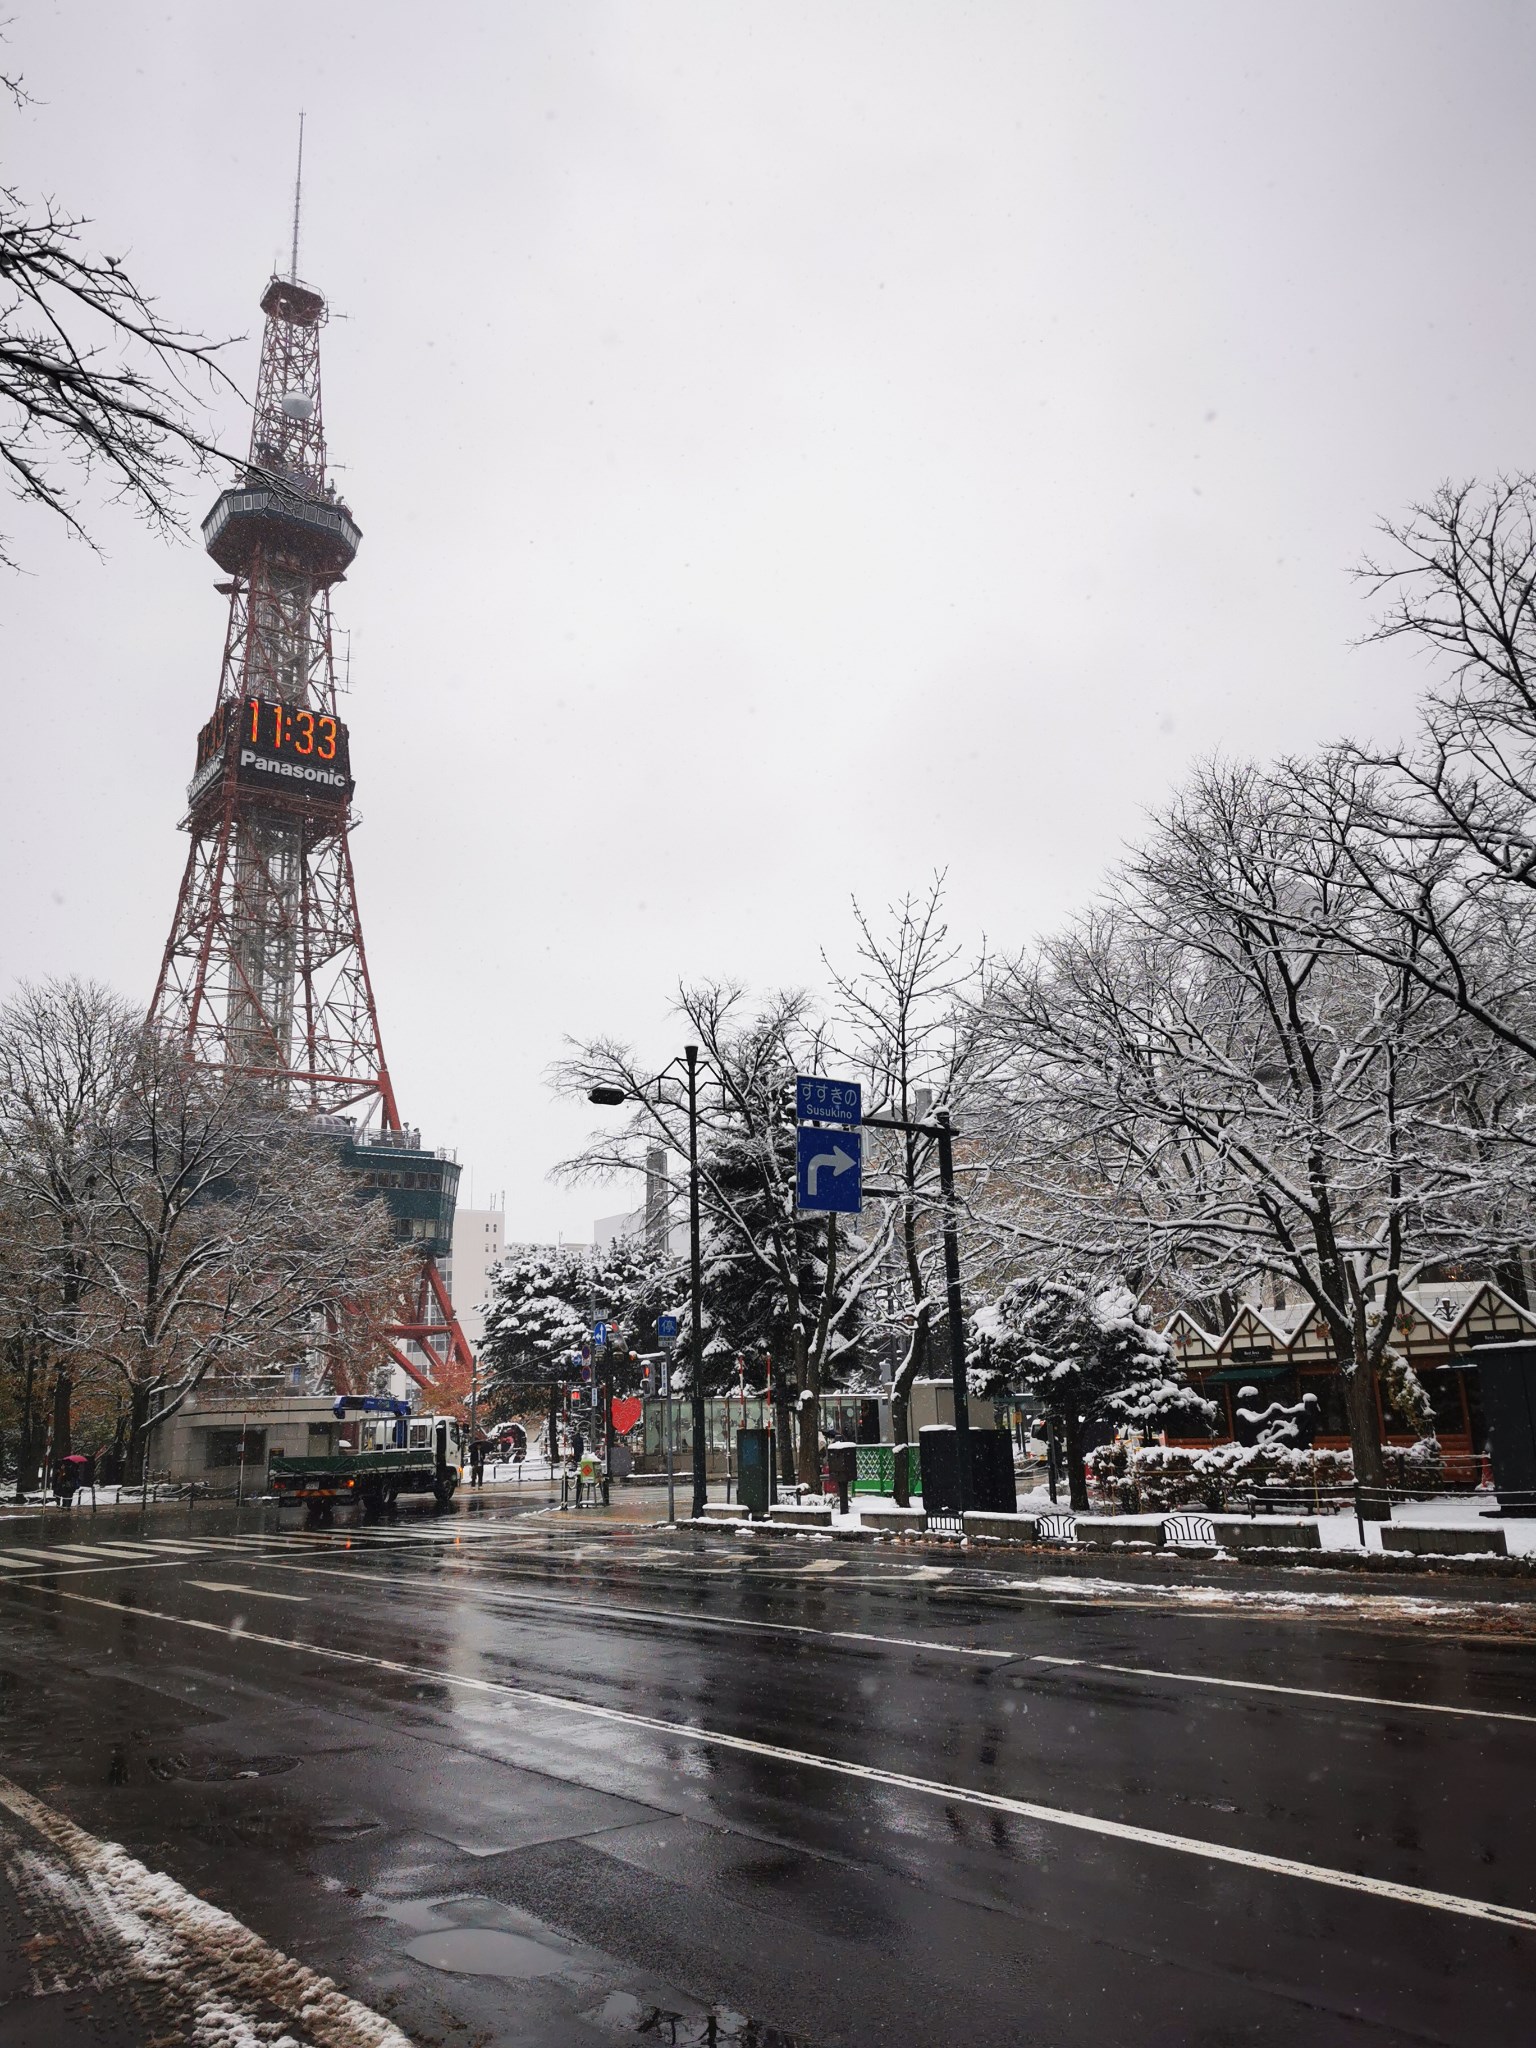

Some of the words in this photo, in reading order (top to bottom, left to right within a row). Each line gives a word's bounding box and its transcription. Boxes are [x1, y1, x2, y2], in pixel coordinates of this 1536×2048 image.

[250, 699, 337, 760] 11:33
[185, 757, 221, 798] Panasonic
[240, 750, 346, 787] Panasonic
[800, 1082, 857, 1107] すすきの
[806, 1104, 853, 1119] Susukino
[661, 1319, 676, 1332] 停
